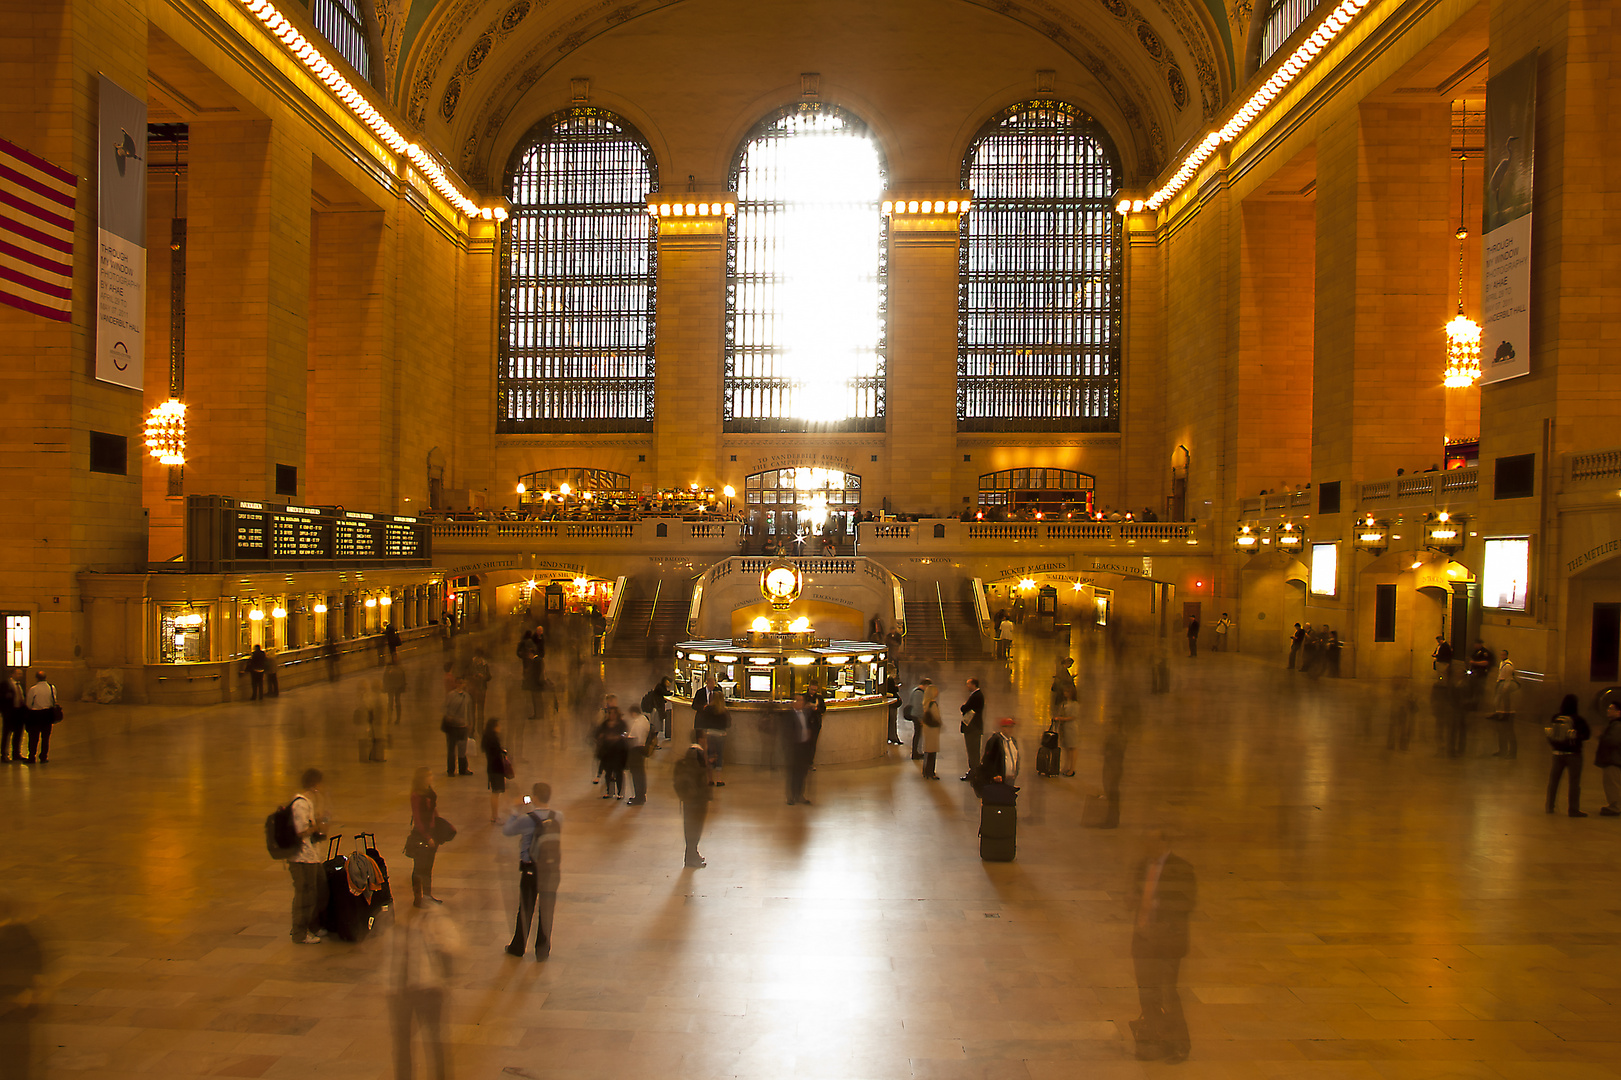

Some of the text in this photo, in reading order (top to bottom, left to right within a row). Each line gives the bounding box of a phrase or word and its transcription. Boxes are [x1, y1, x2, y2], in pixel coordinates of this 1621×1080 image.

[100, 243, 128, 262] THROUGH
[1486, 237, 1514, 255] THROUGH
[100, 256, 133, 276] MY WINDOW
[1486, 247, 1520, 268] MY WINDOW
[1486, 256, 1528, 279] PHOTOGRAPHY
[100, 268, 140, 289] PHOTOGRAPHY
[1486, 276, 1508, 293] BY AHAE
[100, 280, 123, 297] BY AHAE
[100, 292, 114, 303] APRIL
[121, 299, 128, 308] TO
[100, 313, 140, 333] VANDERBILT HALL
[1485, 304, 1526, 324] VANDERBILT HALL
[752, 459, 855, 471] THE CAMPBELL APARTMENT
[771, 453, 816, 461] VANDERBILT
[821, 454, 849, 464] AVENUE
[1567, 539, 1618, 572] THE METLIFE
[452, 560, 586, 573] SUBWAY SHUTTLE 42ND STREET
[1000, 566, 1026, 577] TICKET
[1028, 562, 1066, 572] MACHINES
[1091, 562, 1120, 571] TRACKS
[1045, 573, 1095, 583] WAITING ROOM
